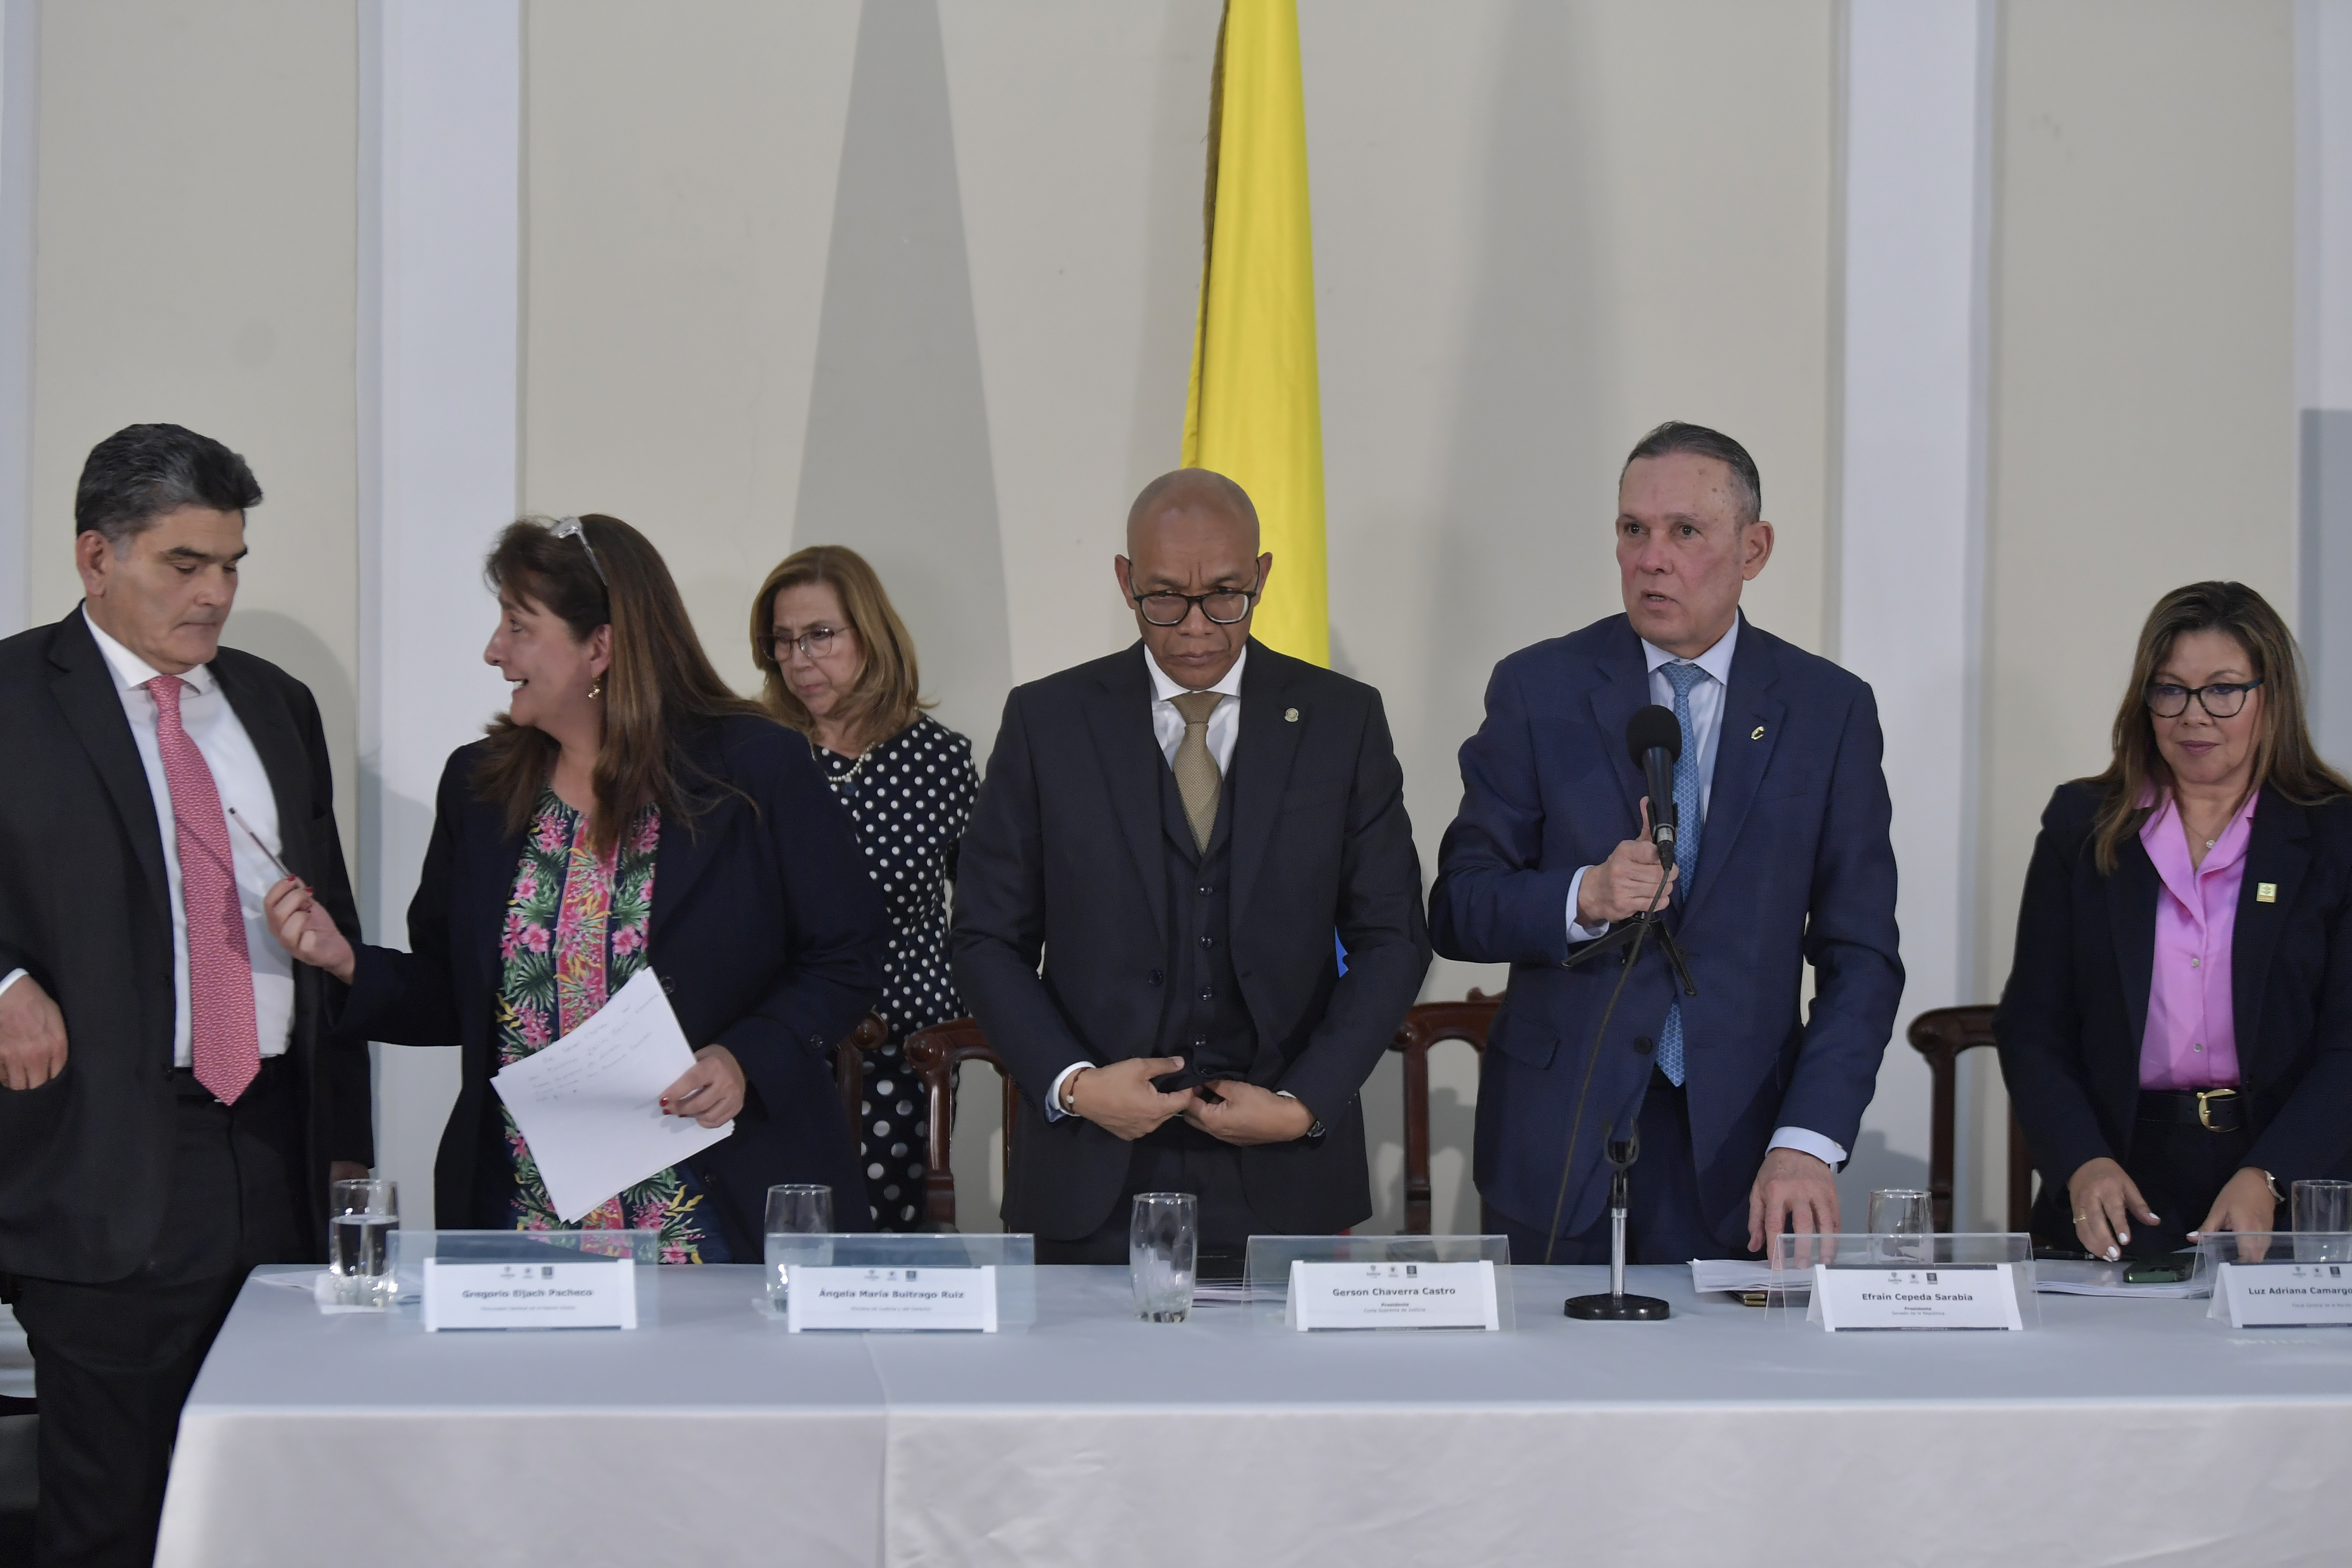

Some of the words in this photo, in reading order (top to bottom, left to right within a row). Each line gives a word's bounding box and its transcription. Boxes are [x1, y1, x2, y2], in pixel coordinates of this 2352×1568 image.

[462, 1290, 509, 1300] Gregorio
[548, 1288, 593, 1297] Pacheco
[818, 1287, 856, 1299] Ángela
[859, 1289, 889, 1298] María
[892, 1291, 938, 1300] Buitrago
[1862, 1292, 1892, 1300] Efraín
[1895, 1293, 1932, 1302] Cepeda
[2310, 1287, 2352, 1296] Camargo
